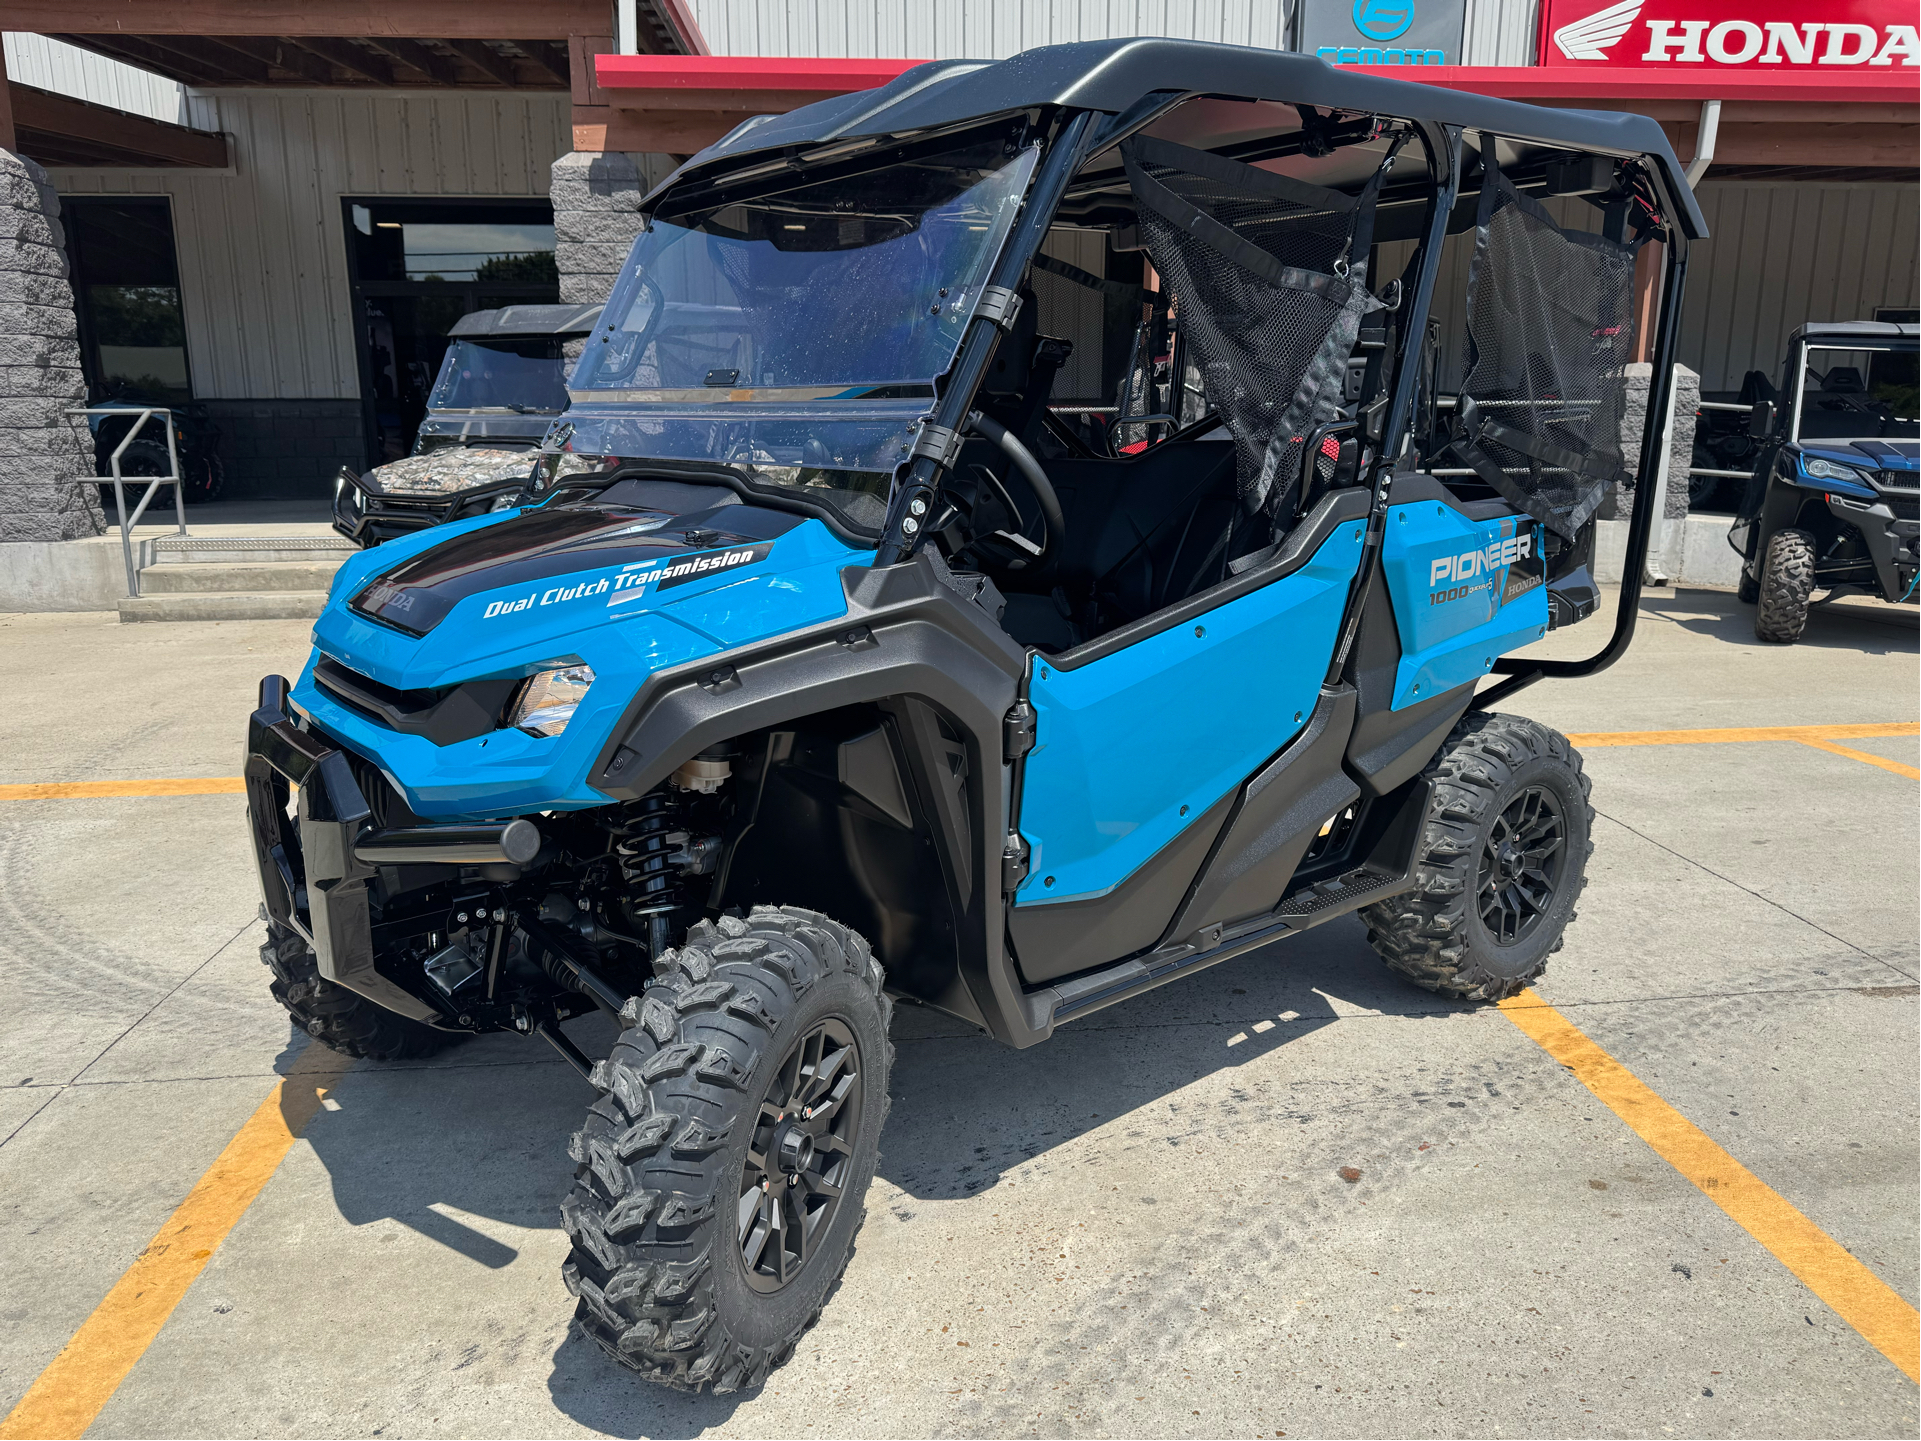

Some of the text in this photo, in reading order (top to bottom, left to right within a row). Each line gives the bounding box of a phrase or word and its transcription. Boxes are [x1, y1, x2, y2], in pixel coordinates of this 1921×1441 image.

[1641, 20, 1920, 66] HONDA
[1429, 533, 1531, 587] PIONEER
[364, 583, 416, 612] HONDA
[483, 550, 754, 619] Dual Clutch Transmission
[1429, 585, 1469, 606] 1000
[1507, 574, 1542, 597] HONDA
